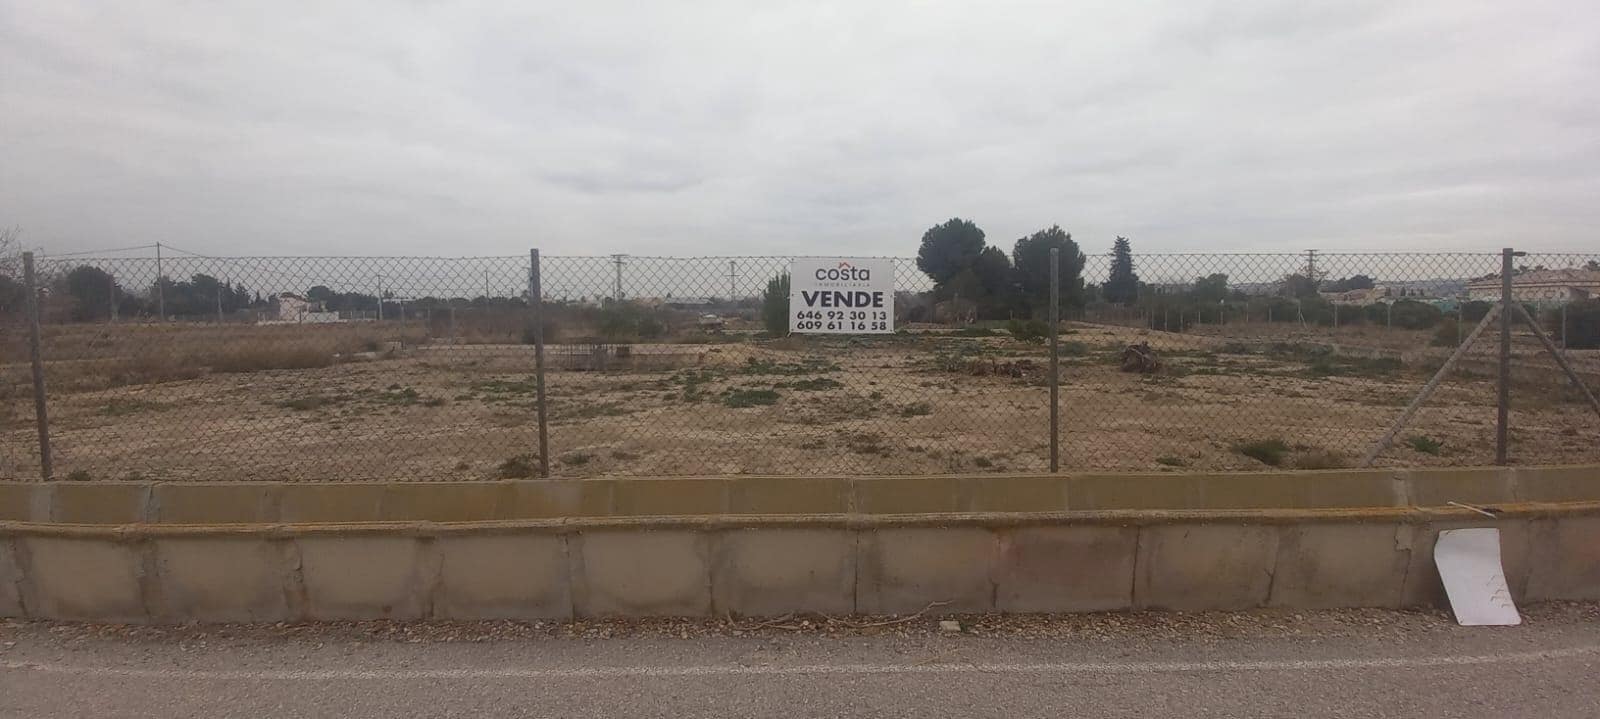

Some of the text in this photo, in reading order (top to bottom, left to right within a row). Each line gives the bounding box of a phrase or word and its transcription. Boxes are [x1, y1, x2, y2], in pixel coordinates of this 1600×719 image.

[815, 266, 870, 281] costa
[801, 290, 883, 308] VENDE
[797, 311, 887, 320] 646 92 30 13
[797, 321, 887, 330] 609 61 16 58
